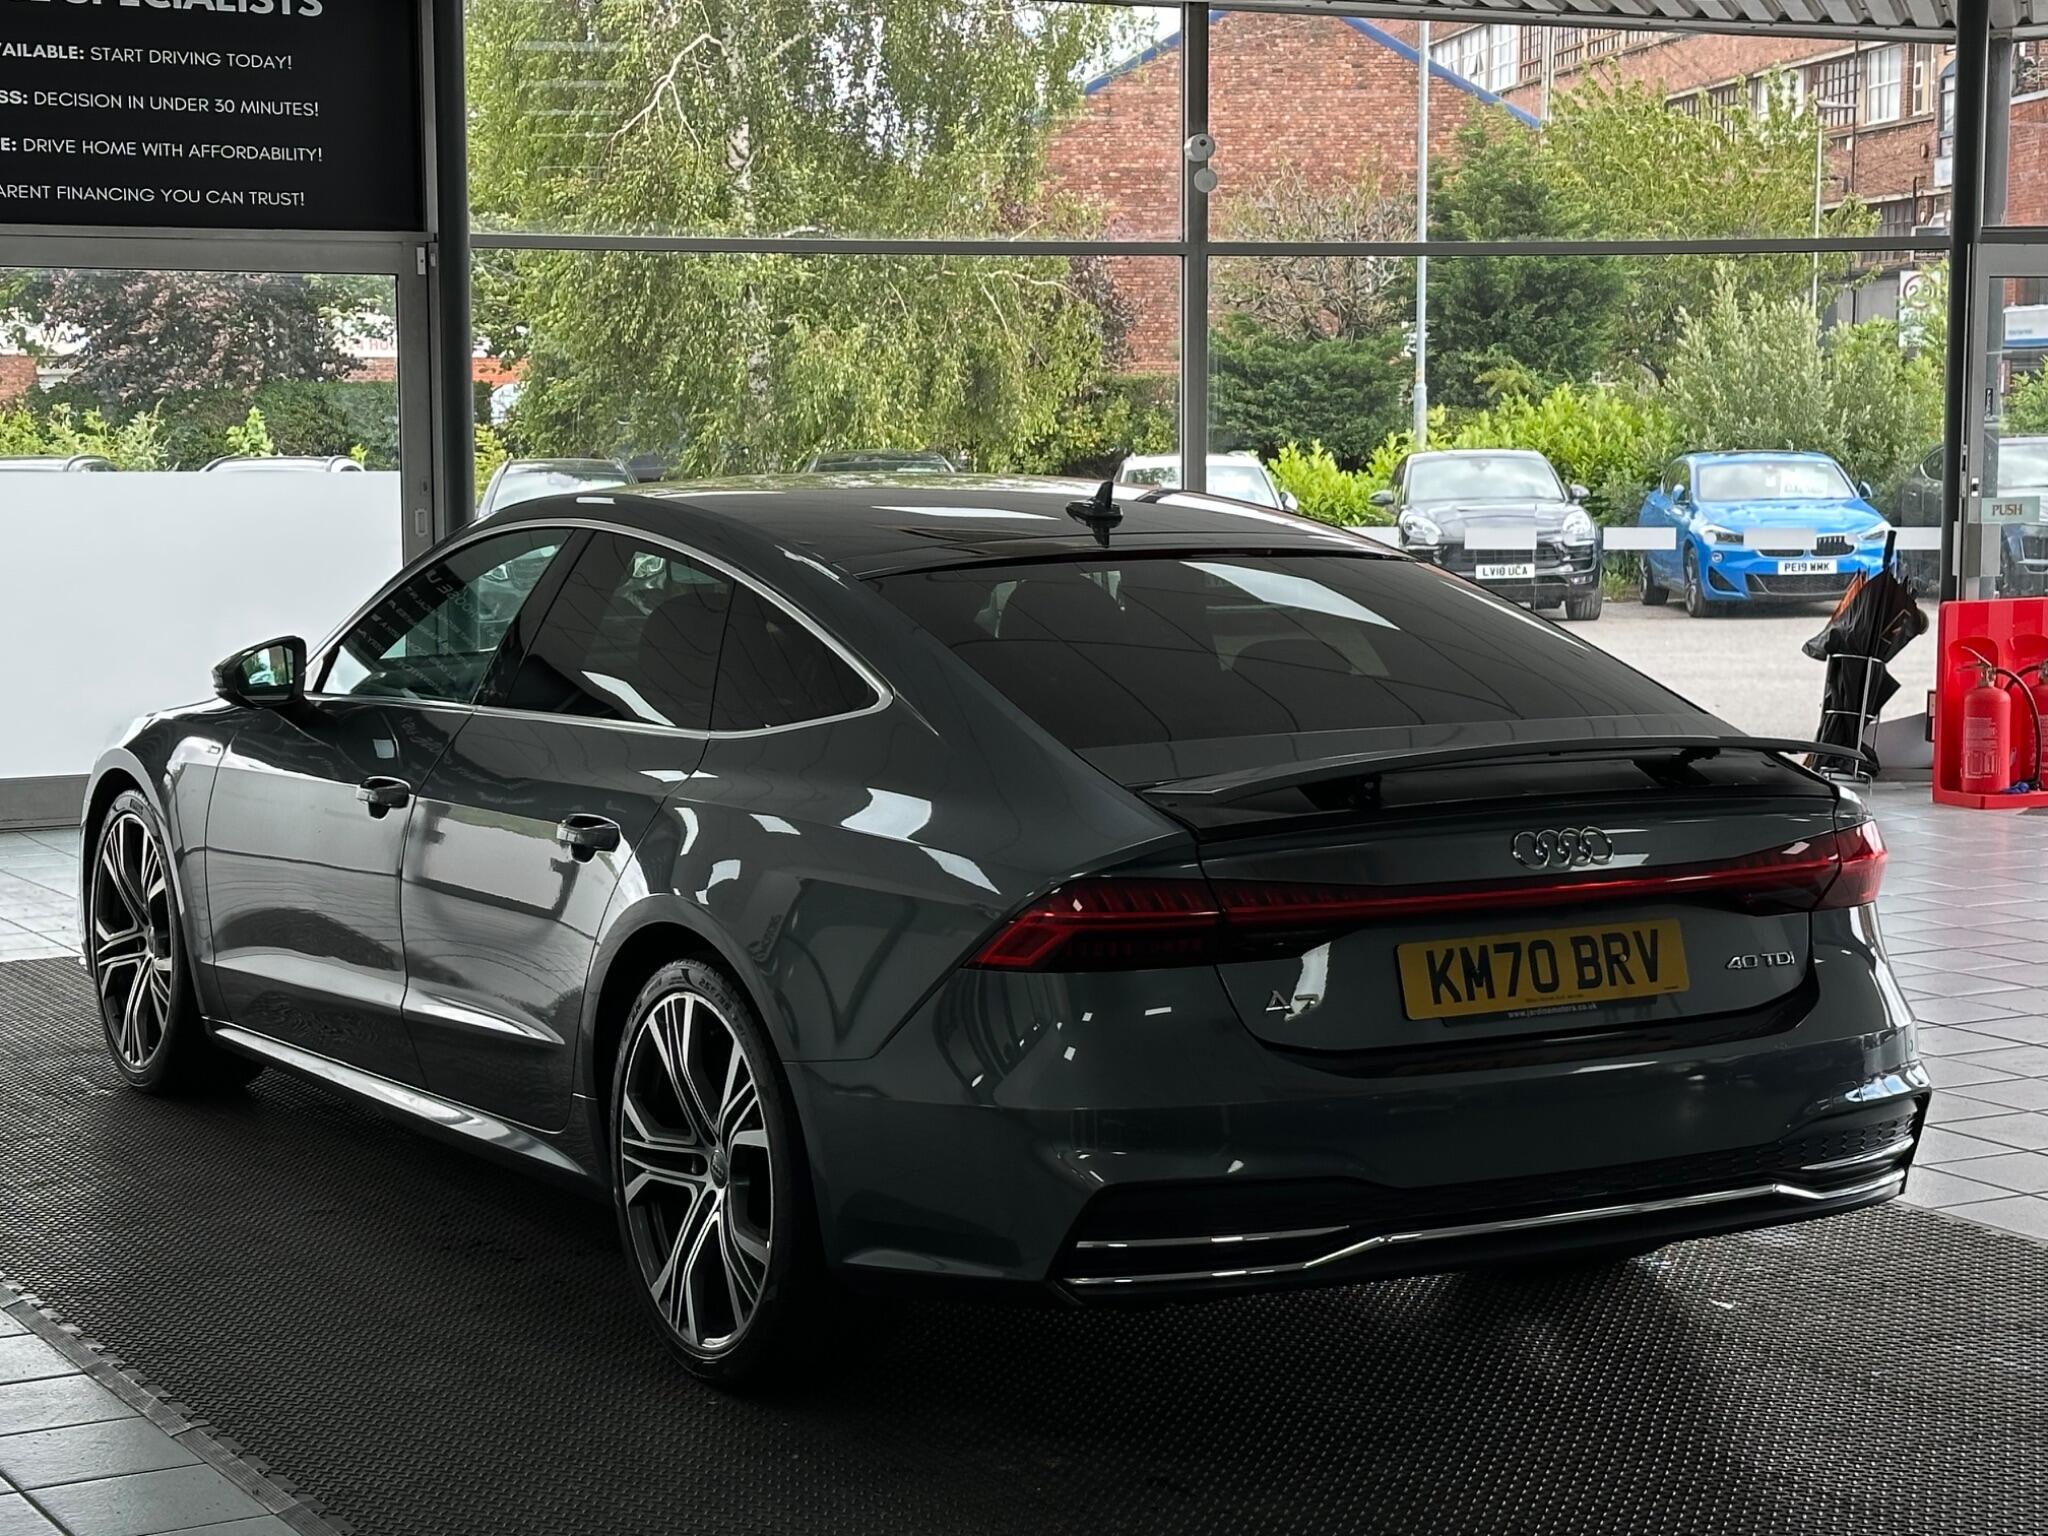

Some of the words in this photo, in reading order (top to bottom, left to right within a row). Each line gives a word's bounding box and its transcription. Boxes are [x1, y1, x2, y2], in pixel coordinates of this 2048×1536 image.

[0, 42, 84, 60] AILABLE:
[90, 46, 143, 63] START
[149, 50, 222, 67] DRIVING
[226, 53, 292, 70] TODAY!
[34, 91, 122, 109] DECISION
[128, 95, 144, 110] IN
[150, 96, 209, 113] UNDER
[214, 99, 236, 114] 30
[241, 101, 319, 117] MINUTES!
[23, 138, 75, 154] DRIVE
[82, 140, 137, 156] HOME
[142, 143, 183, 158] WITH
[189, 144, 323, 163] AFFORDABILITY!
[57, 186, 155, 202] FINANCING
[161, 188, 201, 204] YOU
[206, 190, 244, 205] CAN
[249, 191, 305, 207] TRUST!
[1991, 503, 2023, 516] PUSH
[1784, 562, 1808, 572] PE19
[1425, 938, 1560, 1005] KM70
[1569, 928, 1659, 990] BRV
[1727, 954, 1759, 970] 40
[1760, 951, 1796, 966] TDI
[1265, 989, 1319, 1013] A7
